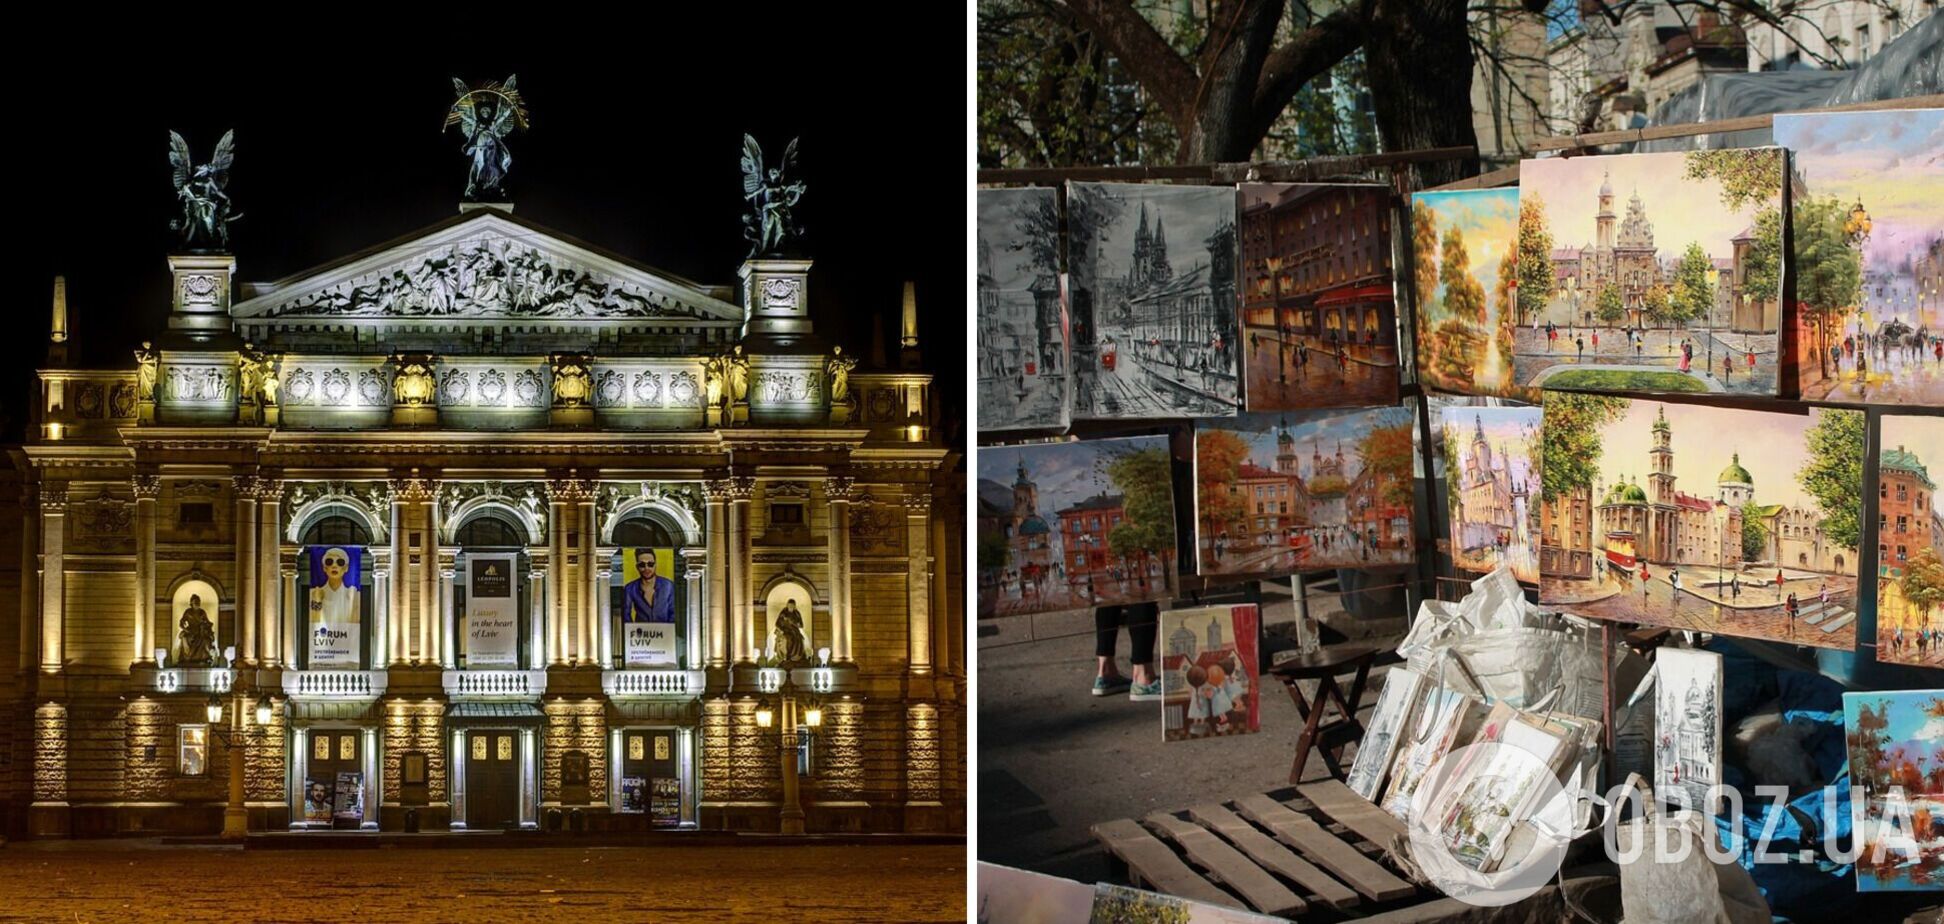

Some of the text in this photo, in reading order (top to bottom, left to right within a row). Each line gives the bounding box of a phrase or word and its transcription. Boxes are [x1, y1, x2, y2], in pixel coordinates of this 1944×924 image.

[481, 619, 492, 627] the
[494, 619, 513, 627] heart
[471, 630, 499, 639] of Lviv
[630, 639, 651, 647] LVIV
